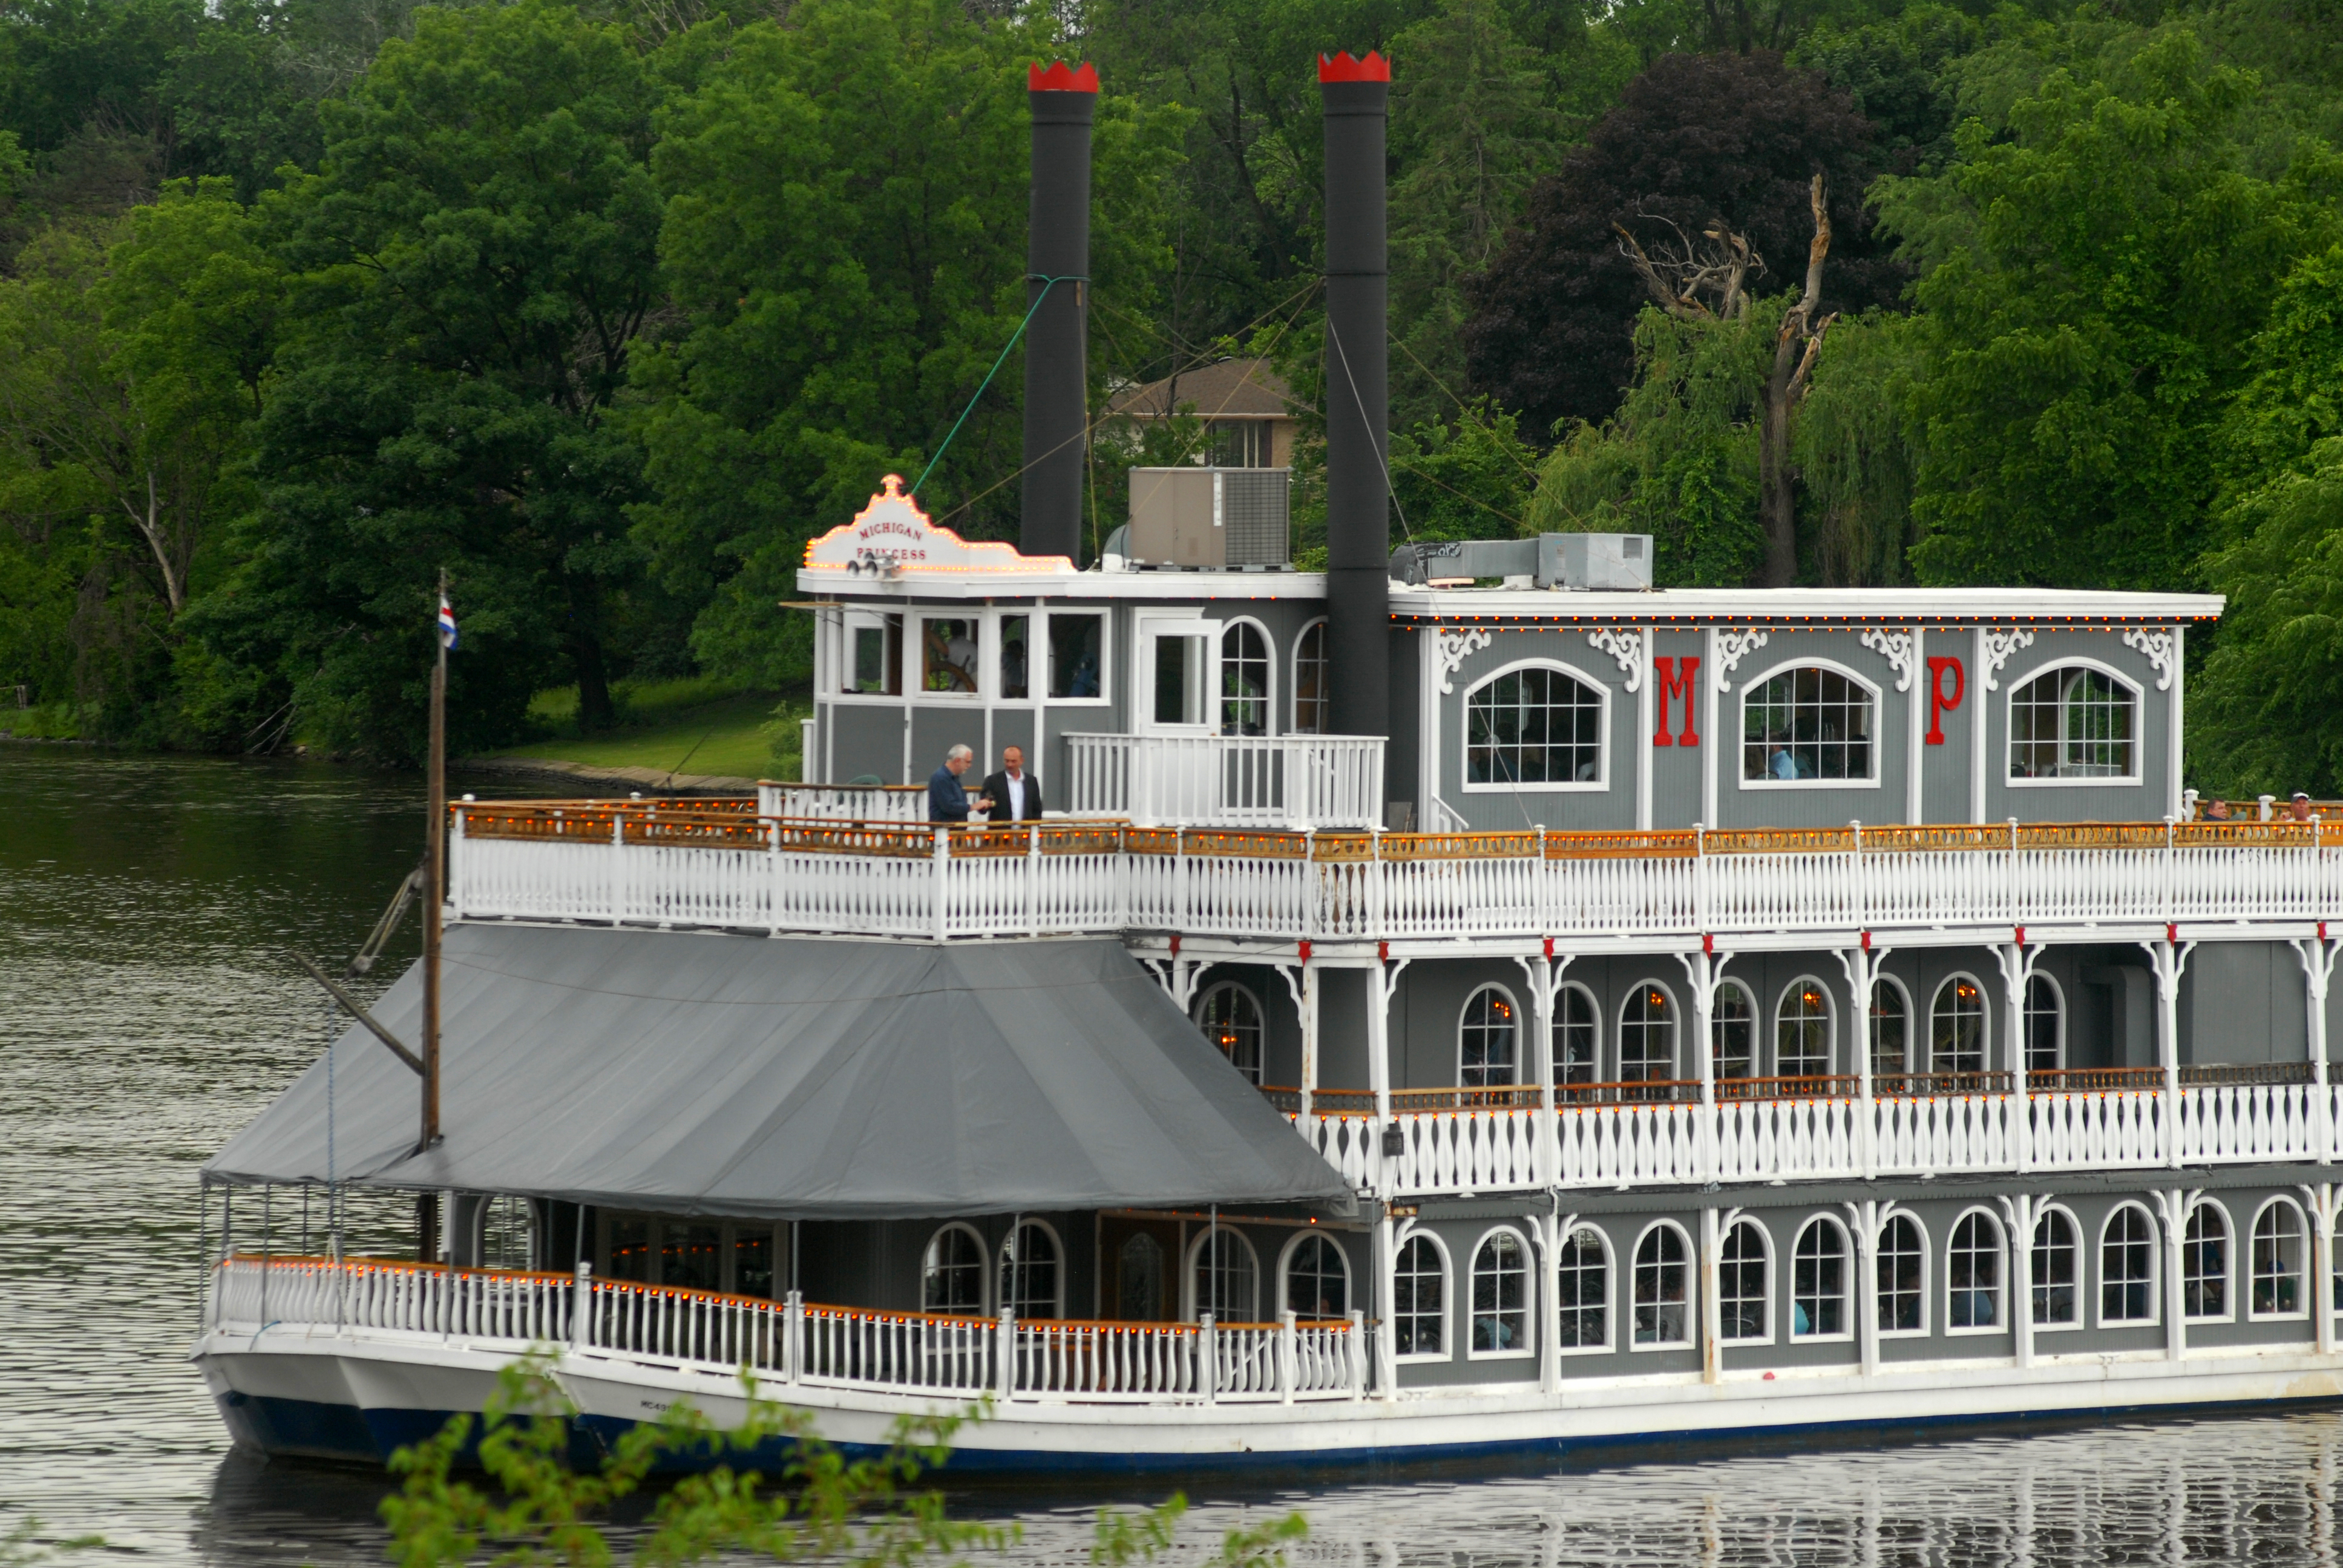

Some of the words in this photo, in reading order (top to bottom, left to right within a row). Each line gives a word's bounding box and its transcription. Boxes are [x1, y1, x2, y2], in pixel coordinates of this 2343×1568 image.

[859, 523, 922, 541] MICHIGAN
[1654, 656, 1700, 746] M
[1925, 656, 1965, 745] P
